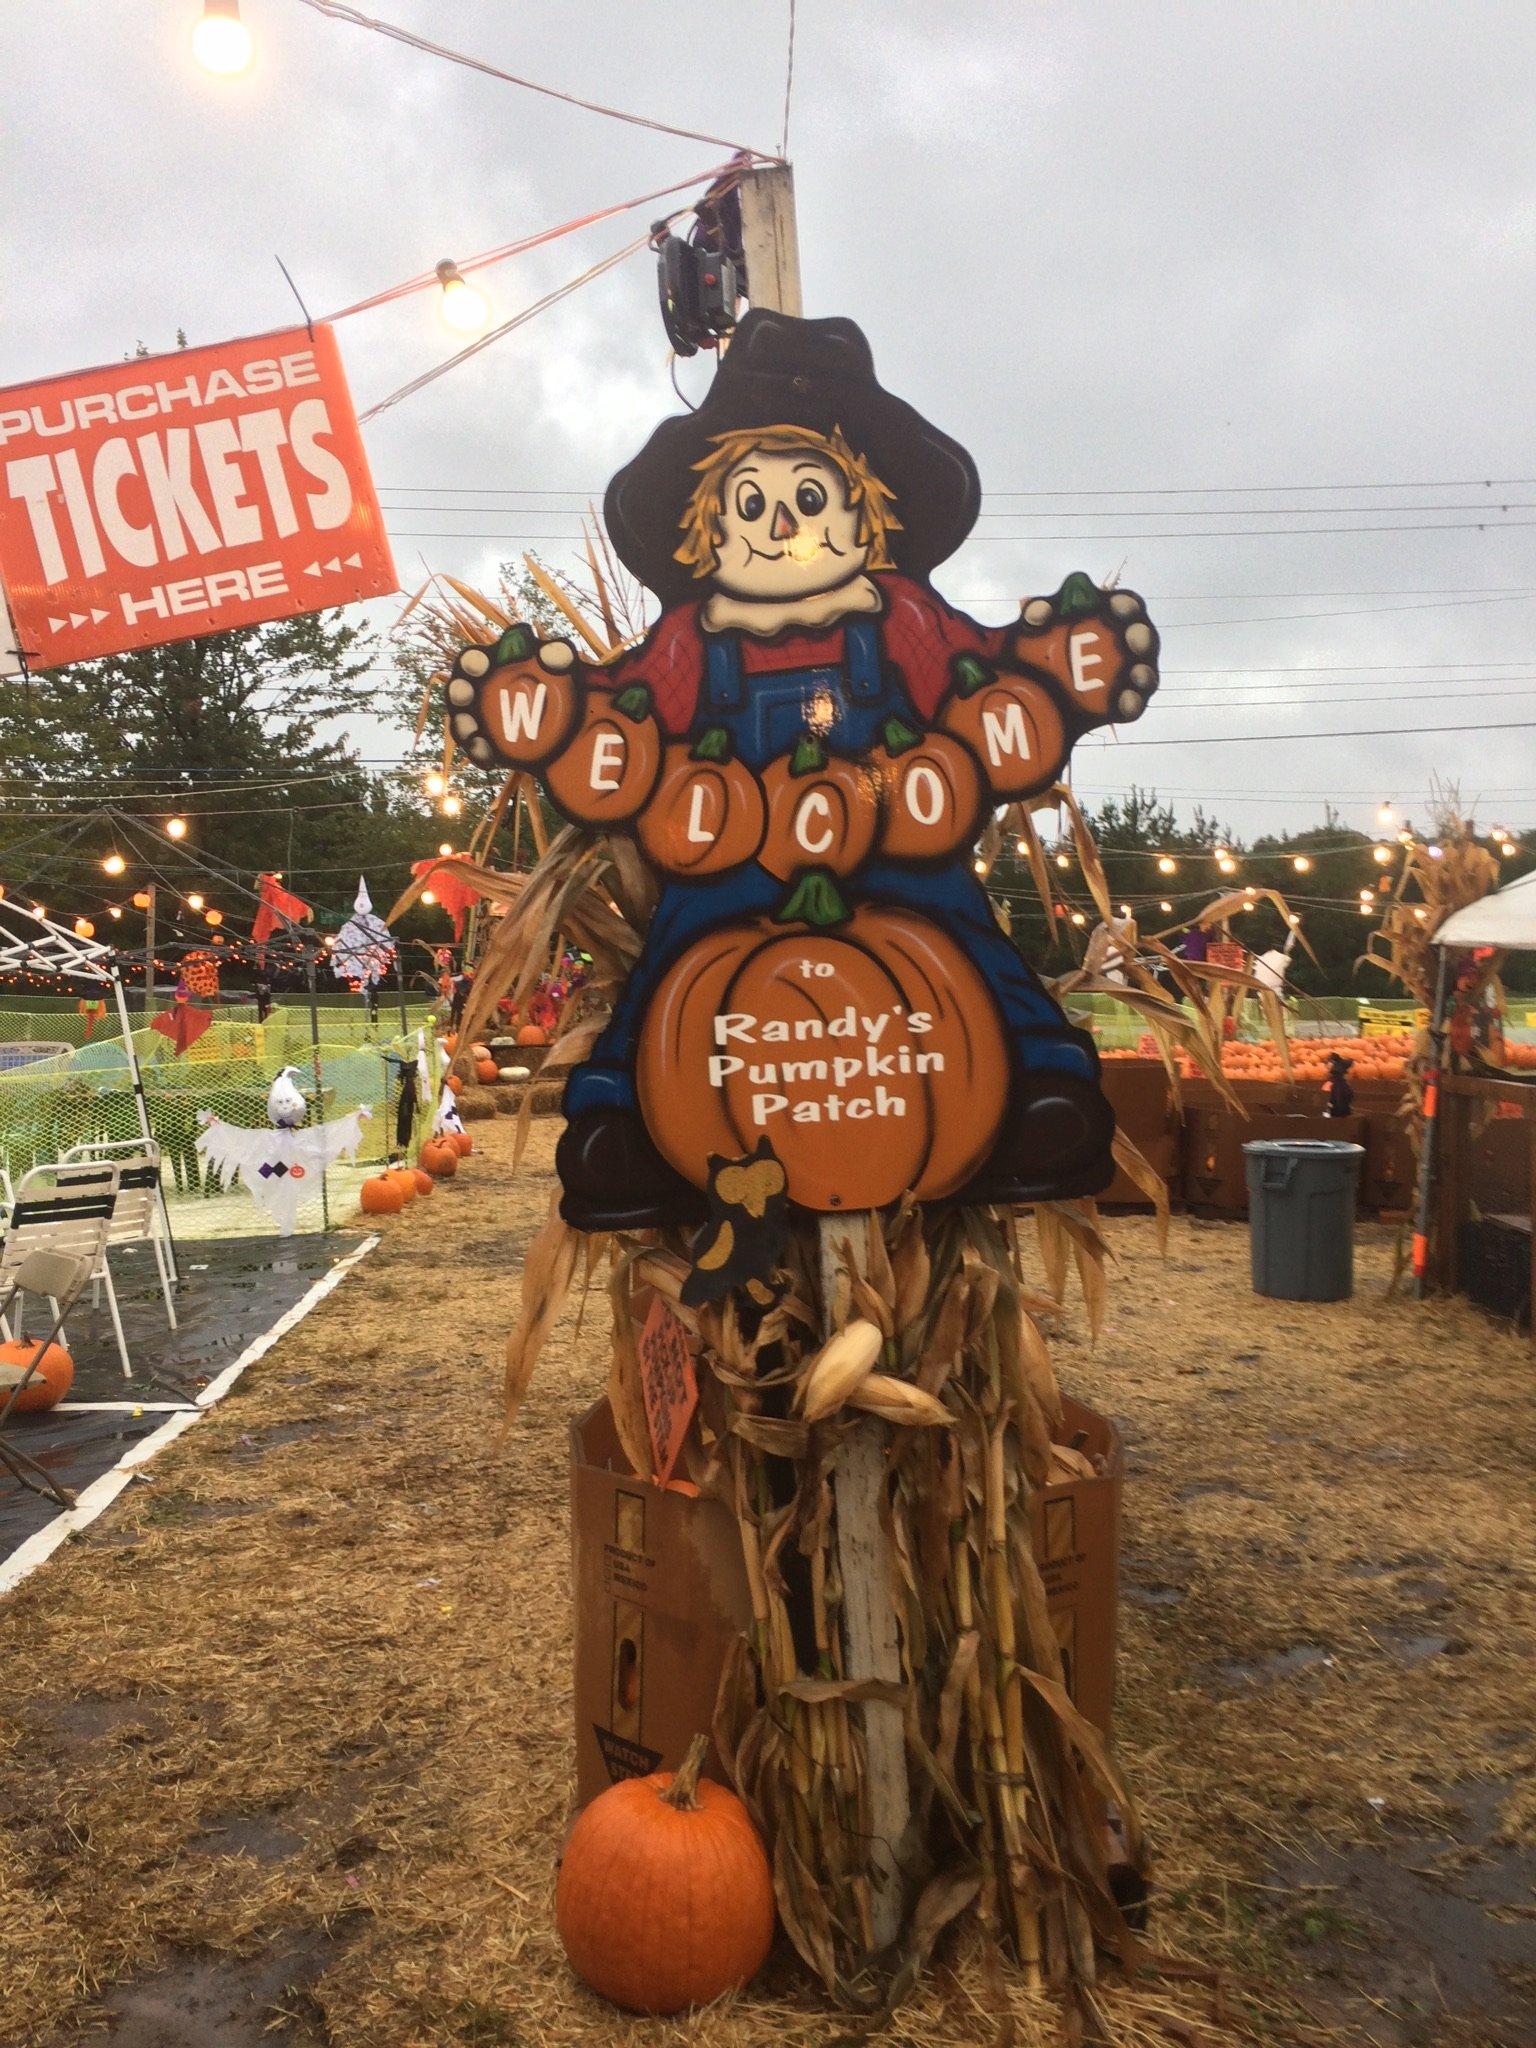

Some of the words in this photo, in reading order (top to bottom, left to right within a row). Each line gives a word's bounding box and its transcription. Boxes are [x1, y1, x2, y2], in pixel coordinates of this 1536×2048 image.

[0, 350, 321, 445] PURCHASE
[6, 398, 352, 586] TICKETS
[119, 560, 289, 626] HERE
[499, 632, 1105, 853] WELCOME
[799, 959, 835, 979] to
[714, 1005, 933, 1046] Randy's
[708, 1045, 945, 1087] Pumpkin
[752, 1086, 906, 1126] Patch
